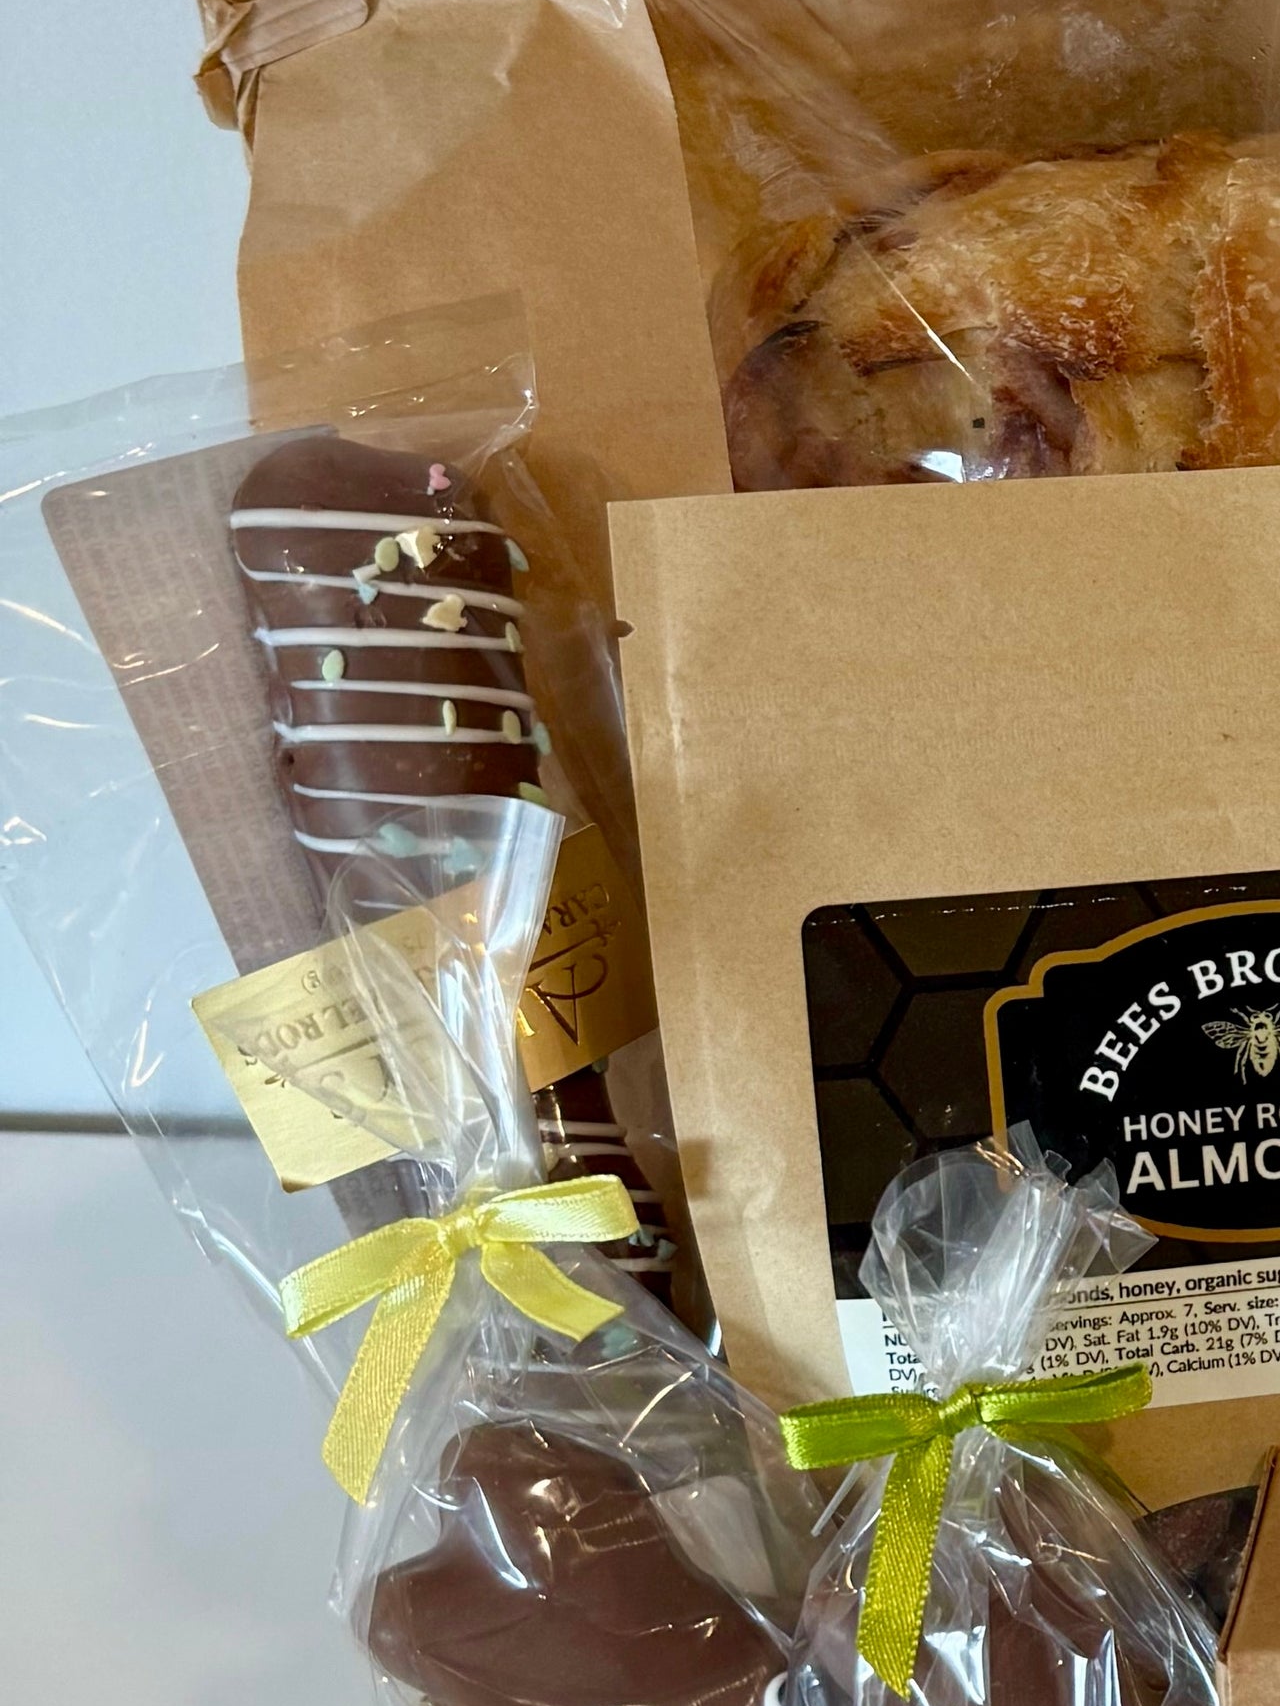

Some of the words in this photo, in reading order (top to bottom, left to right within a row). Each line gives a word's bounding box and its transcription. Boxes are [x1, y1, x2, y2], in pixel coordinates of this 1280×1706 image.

[1080, 982, 1181, 1102] BEES
[1123, 1105, 1245, 1142] HONEY
[1119, 1279, 1180, 1298] honey,
[1185, 1270, 1252, 1291] organic
[1050, 1316, 1112, 1332] ervings:
[1184, 1304, 1197, 1318] 7,
[1204, 1301, 1240, 1314] Serv.
[1247, 1296, 1278, 1310] size:
[1117, 1329, 1140, 1343] Fat
[1147, 1326, 1178, 1341] 1.9g
[1184, 1320, 1222, 1337] (10%
[1041, 1354, 1069, 1371] (1%
[1115, 1345, 1153, 1360] Total
[1161, 1340, 1199, 1355] Carb.
[1206, 1337, 1234, 1352] 21g
[1240, 1332, 1268, 1348] (7%
[1167, 1356, 1225, 1373] Calcium
[1228, 1352, 1256, 1368] (1%
